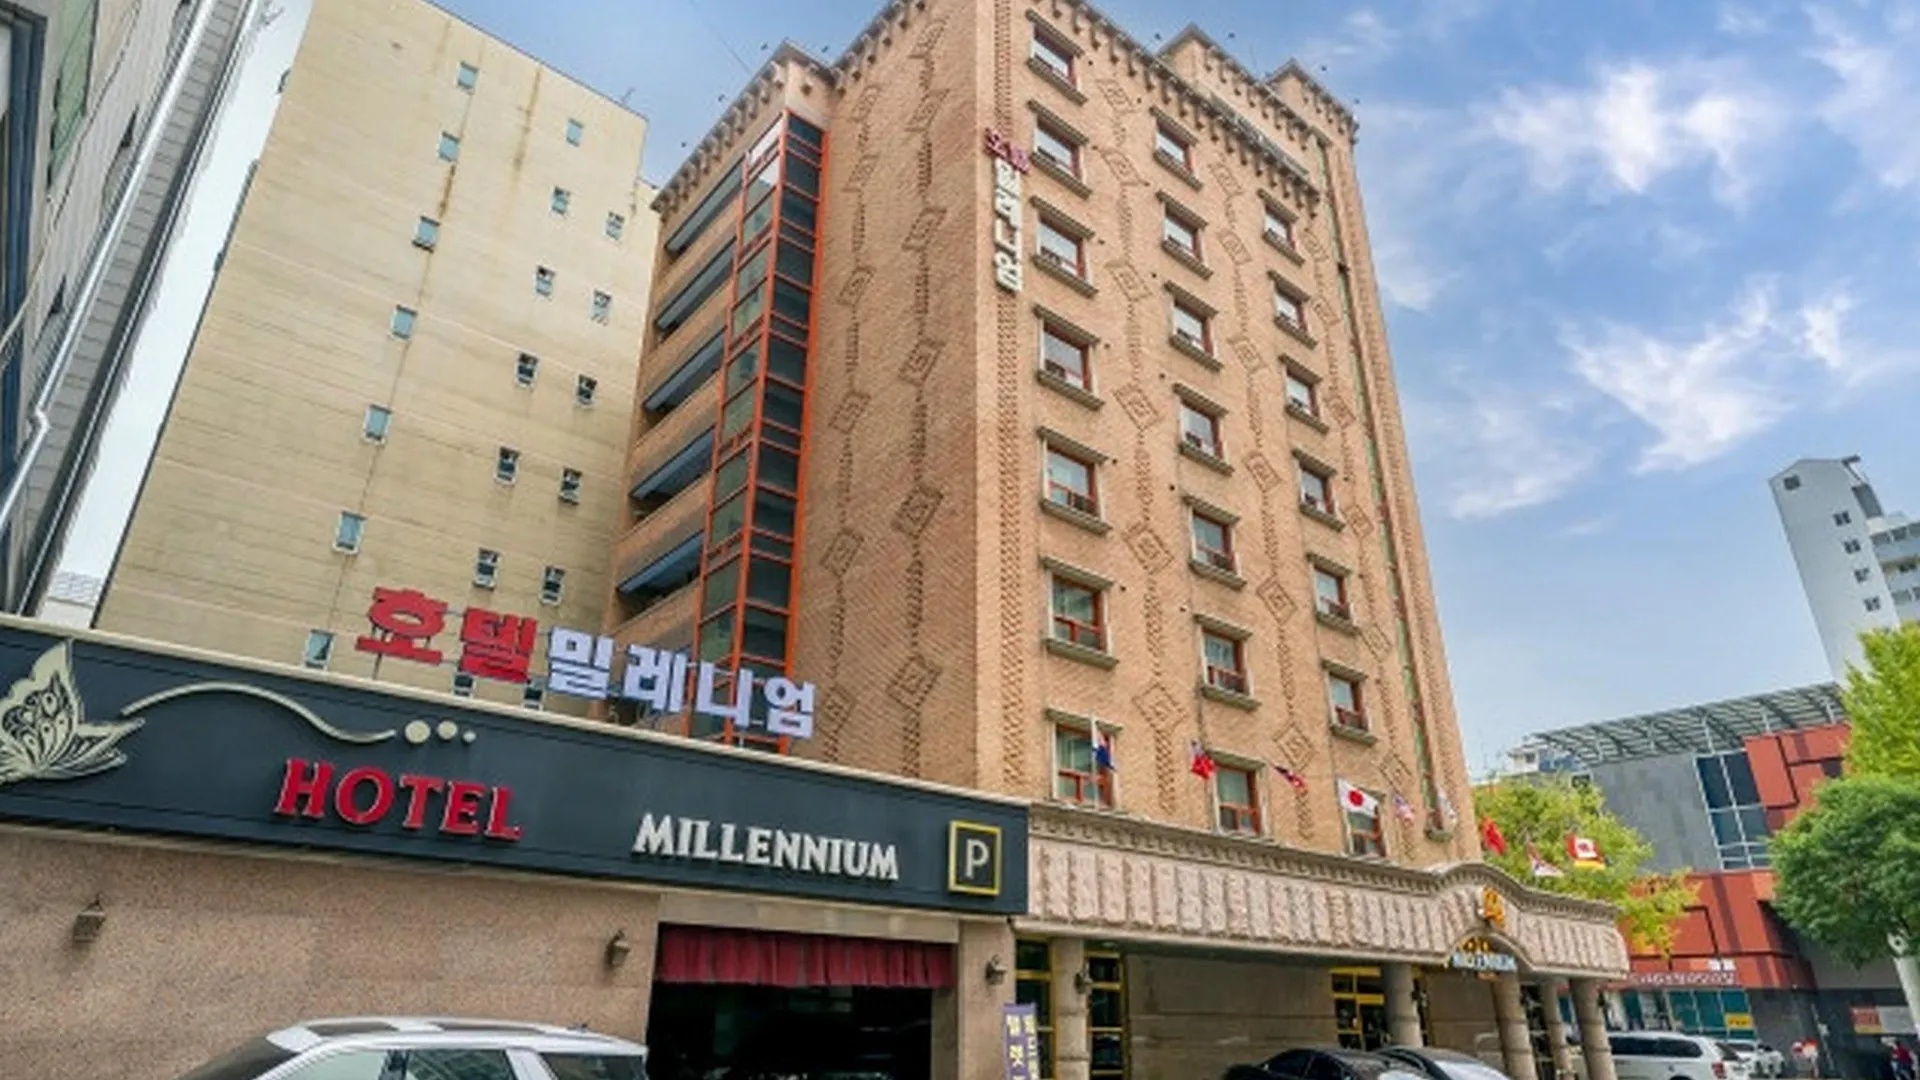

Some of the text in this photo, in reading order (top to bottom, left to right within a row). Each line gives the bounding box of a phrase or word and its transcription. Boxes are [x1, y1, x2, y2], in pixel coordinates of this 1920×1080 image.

[355, 586, 815, 738] 호텔 밀레니엄
[274, 757, 524, 841] HOTEL
[632, 813, 899, 880] MILLENNIUM
[965, 839, 989, 879] P
